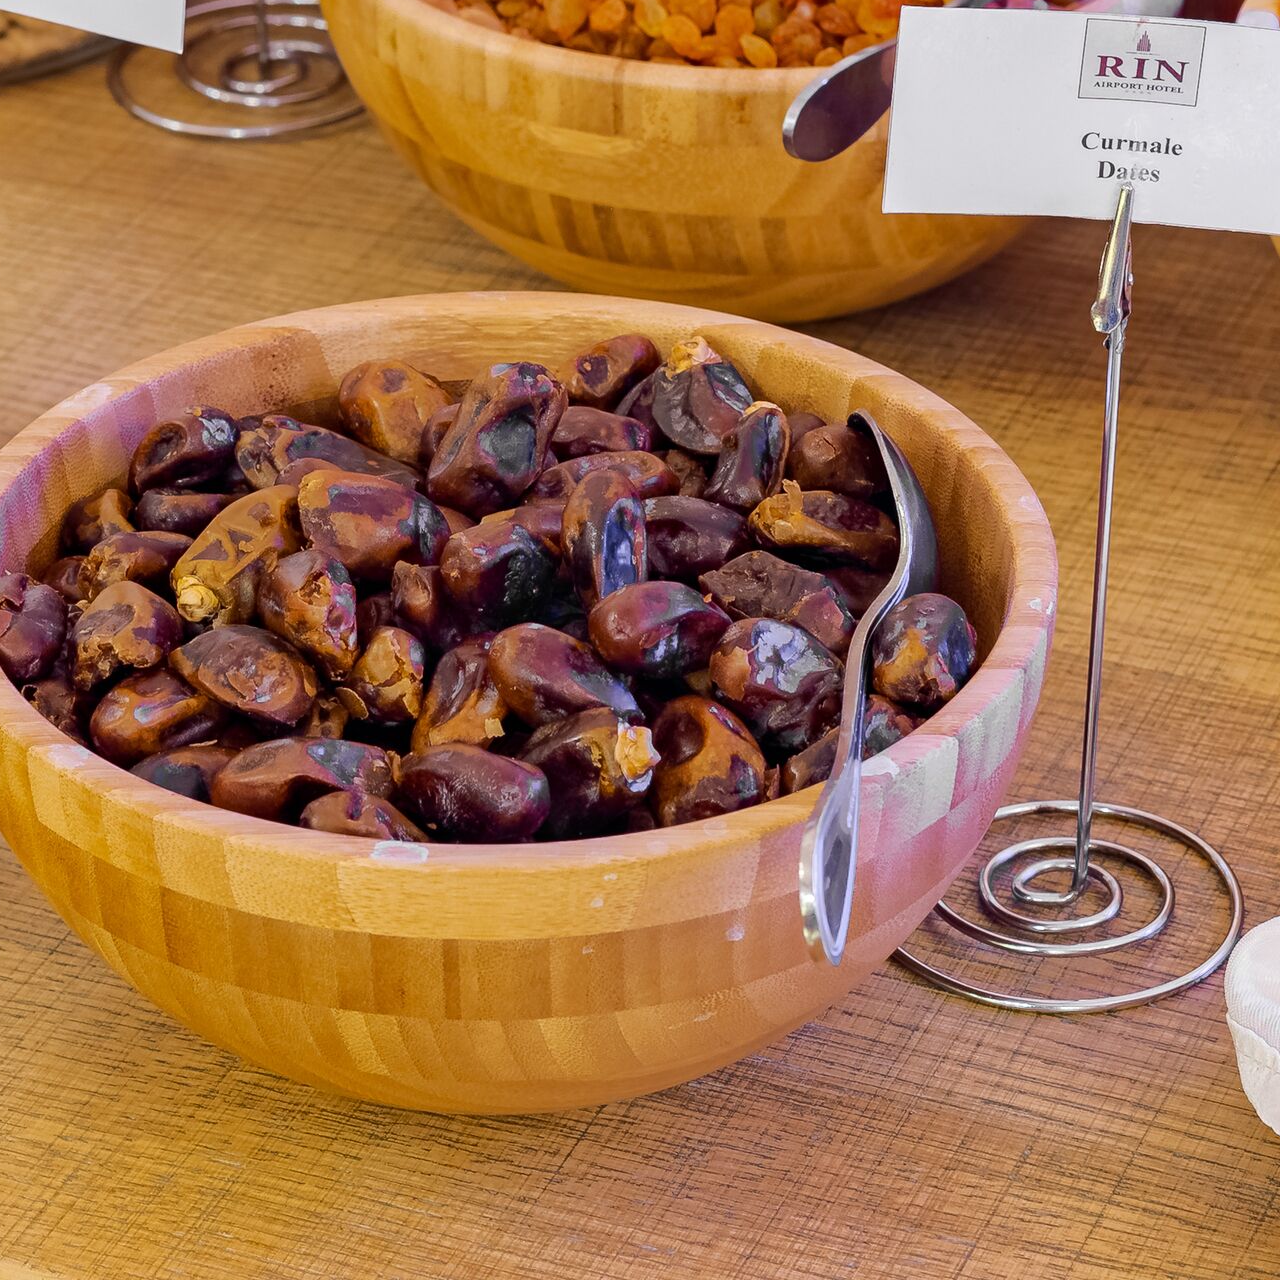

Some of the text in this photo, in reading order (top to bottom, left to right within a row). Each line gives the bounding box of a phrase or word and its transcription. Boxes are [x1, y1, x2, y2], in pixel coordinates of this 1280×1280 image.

[1094, 55, 1190, 83] RIN
[1093, 81, 1184, 94] AIRPORT HOTEL
[1081, 132, 1183, 156] Curmale
[1096, 161, 1161, 183] Dates
